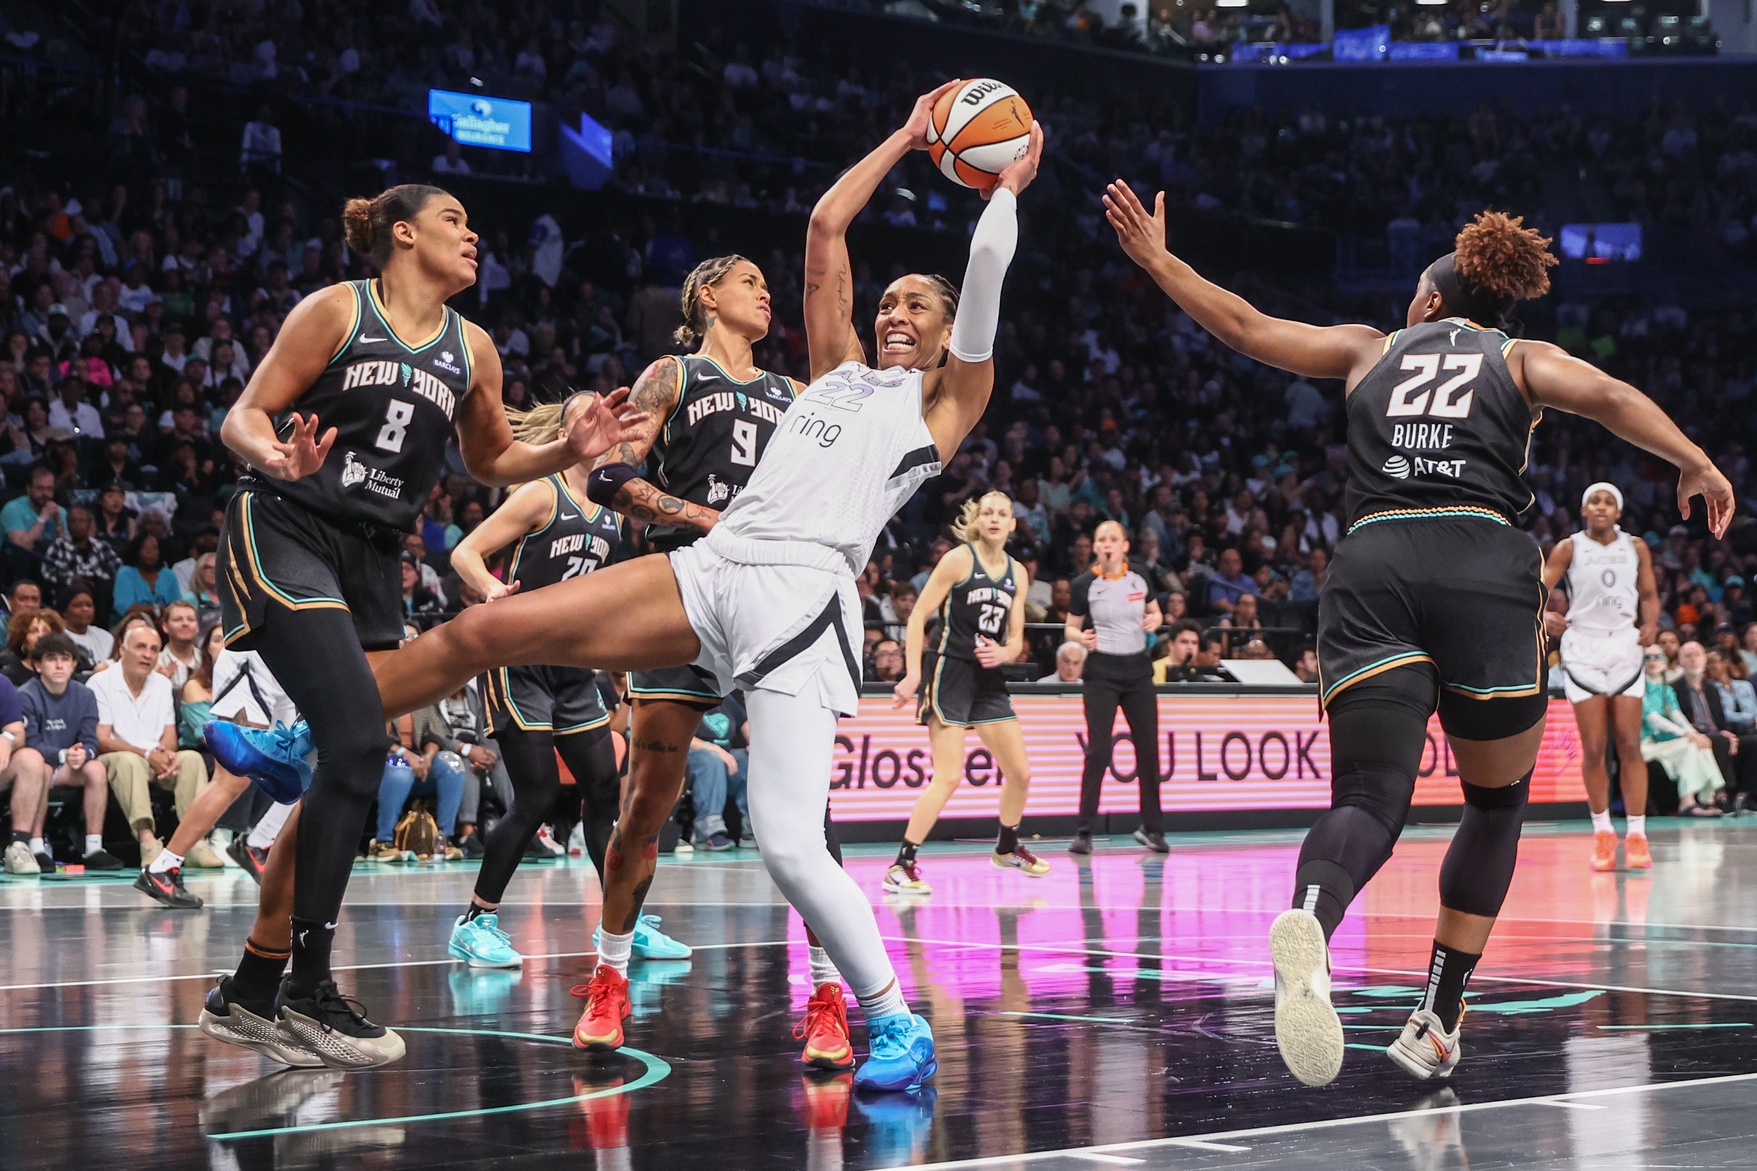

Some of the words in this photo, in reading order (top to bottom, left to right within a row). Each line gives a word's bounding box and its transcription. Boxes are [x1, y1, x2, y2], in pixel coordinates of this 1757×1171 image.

[434, 359, 460, 374] BARCLAYS
[343, 361, 399, 391] NEW
[412, 367, 456, 422] YORK
[804, 381, 875, 412] 22
[1386, 353, 1484, 418] 22
[687, 392, 735, 426] NEW
[748, 396, 785, 426] YO
[375, 398, 415, 453] 8
[789, 412, 842, 448] ring
[1391, 423, 1453, 449] BURKE
[731, 418, 758, 467] 9
[369, 467, 404, 488] Liberty
[1414, 456, 1466, 478] AT&T
[364, 480, 401, 499] Mutual
[550, 534, 584, 559] NEW
[1601, 568, 1616, 588] 0
[966, 587, 992, 606] NEW
[978, 603, 1006, 634] 23
[829, 735, 1003, 789] Glose
[1195, 730, 1322, 782] LOOK
